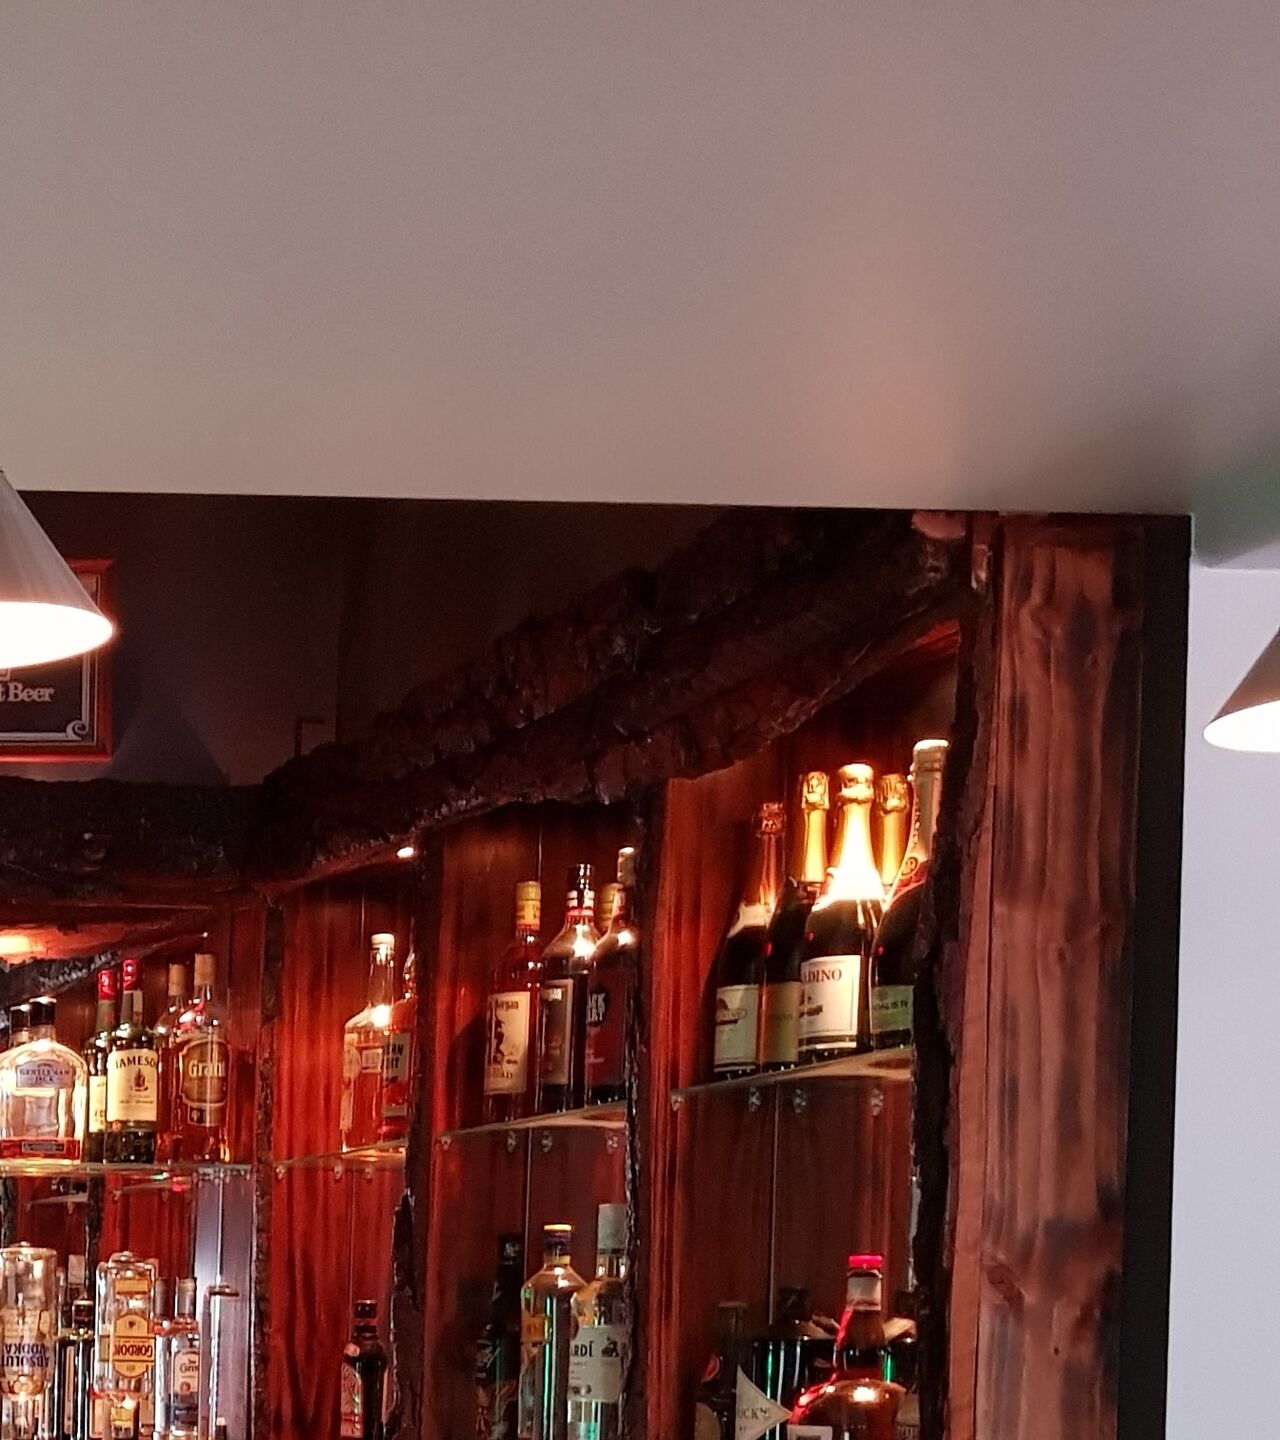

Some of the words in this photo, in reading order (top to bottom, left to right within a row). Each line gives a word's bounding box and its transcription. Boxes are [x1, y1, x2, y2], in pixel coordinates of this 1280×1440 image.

[8, 681, 55, 702] Beer
[116, 1055, 156, 1069] JAMESO
[5, 1343, 45, 1355] VODKA
[1, 1355, 49, 1368] ABSOLUT
